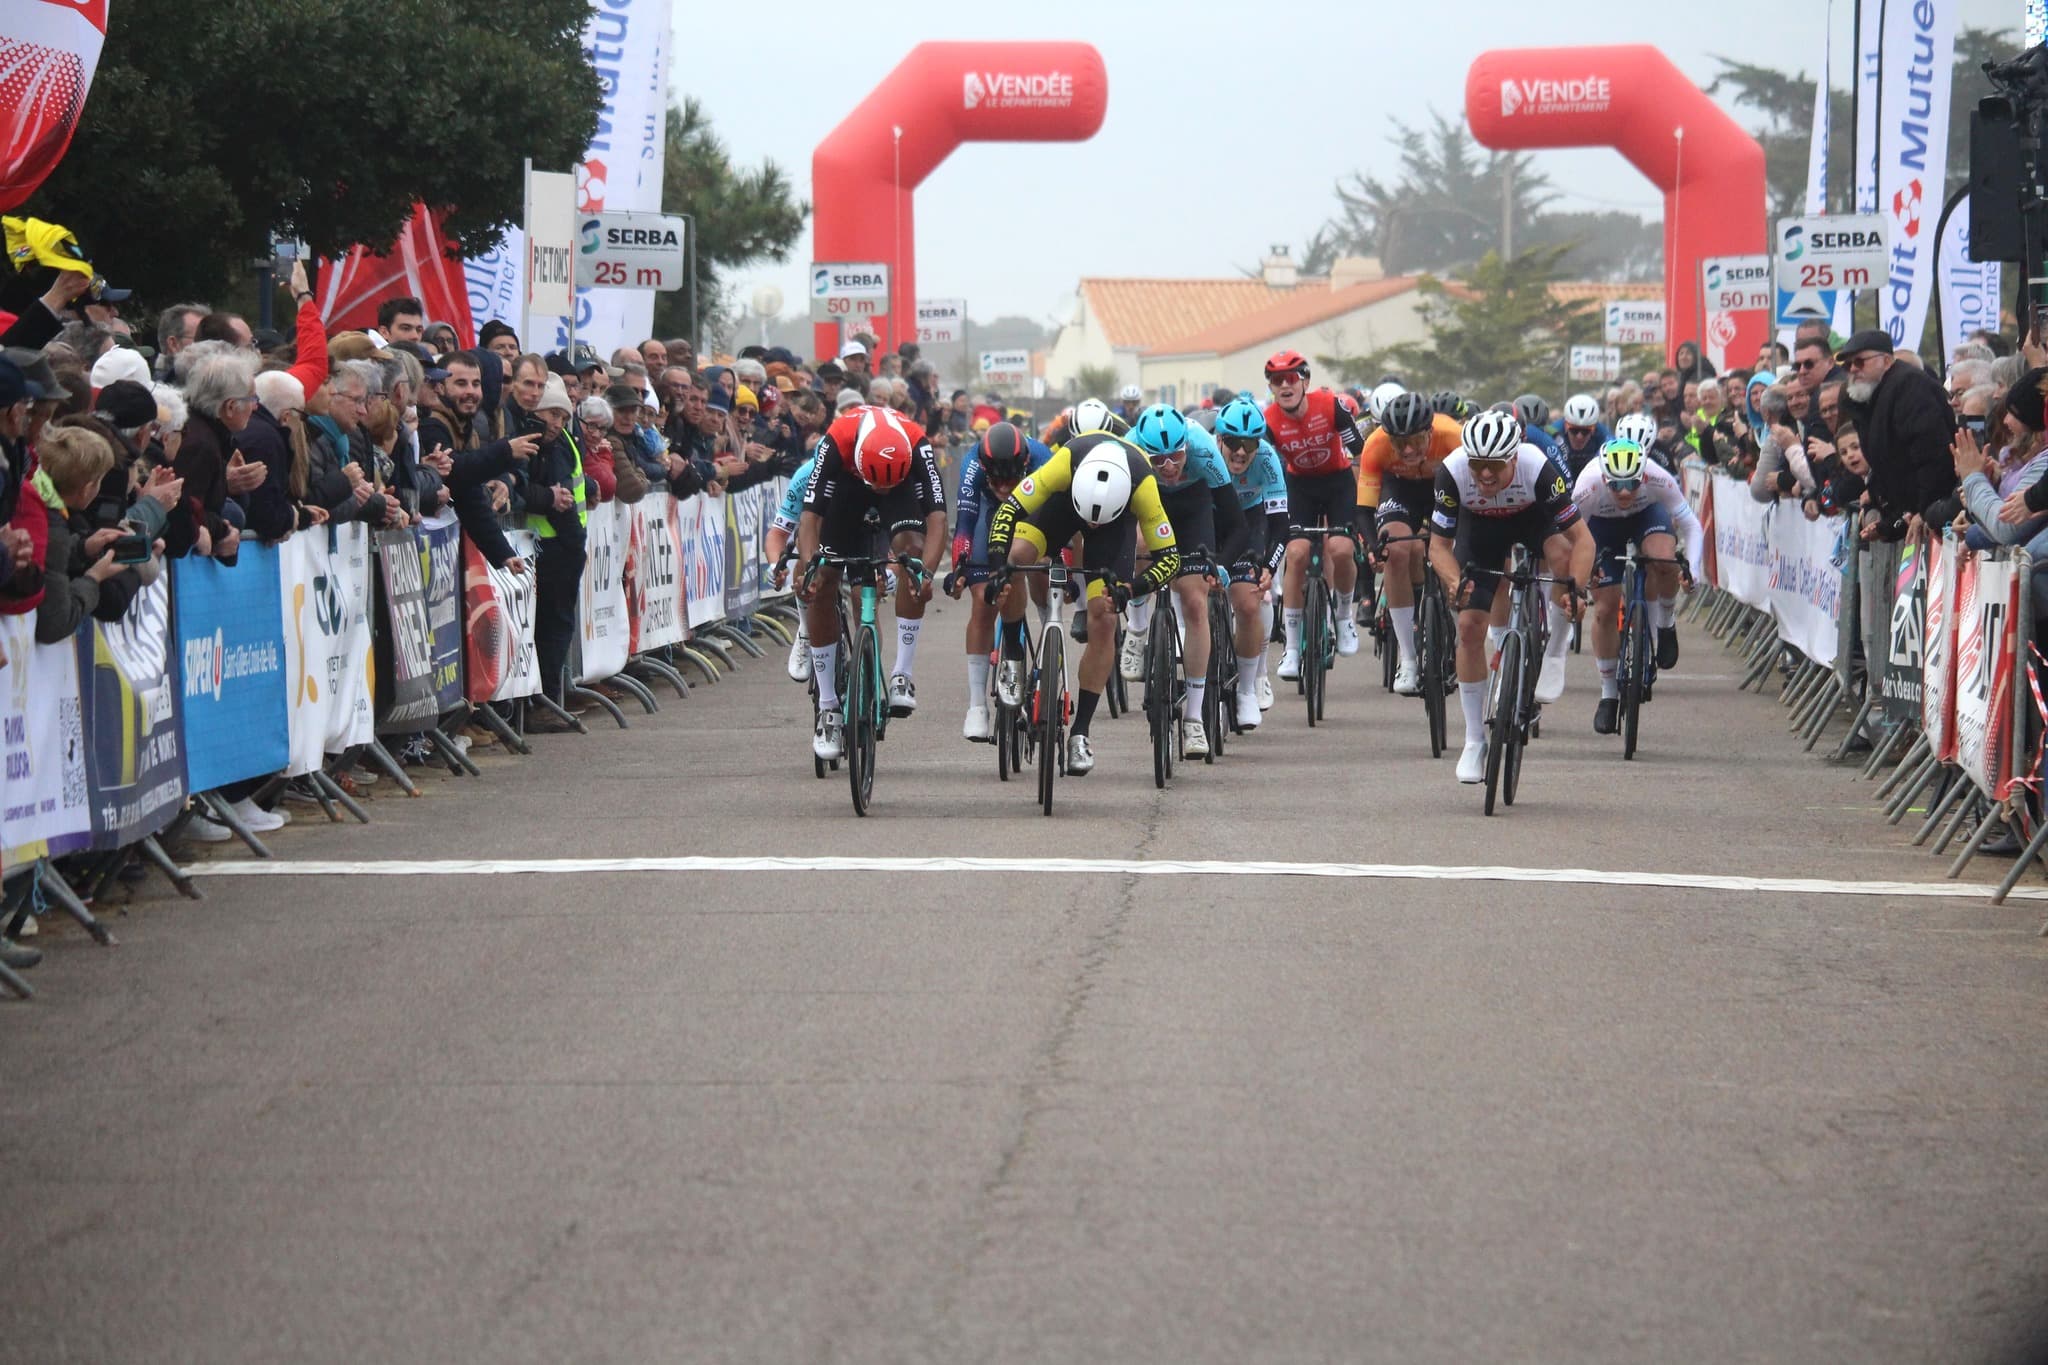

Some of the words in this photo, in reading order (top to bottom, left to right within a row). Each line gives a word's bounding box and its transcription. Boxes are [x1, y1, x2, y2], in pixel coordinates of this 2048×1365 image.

[985, 72, 1073, 97] VENDÉE
[1522, 76, 1610, 103] VENDÉE
[606, 229, 679, 246] SERBA
[1810, 231, 1883, 247] SERBA
[533, 246, 570, 284] PIETONS
[594, 262, 628, 286] 25
[637, 266, 663, 286] m
[833, 274, 884, 287] SERBA
[1800, 264, 1834, 288] 25
[1843, 267, 1869, 285] m
[828, 298, 851, 314] 50
[857, 301, 875, 314] m
[1720, 291, 1746, 308] 50
[1750, 294, 1769, 307] m
[919, 308, 958, 319] SERBA
[1623, 311, 1662, 322] SERBA
[936, 330, 951, 341] m
[1618, 328, 1636, 342] 75
[1640, 330, 1656, 342] m
[986, 372, 1006, 383] 100
[1011, 374, 1023, 383] m
[808, 442, 830, 489] LEGENDRE
[964, 459, 980, 486] PARIS
[926, 457, 944, 504] LEGENDRE
[1159, 526, 1169, 536] U
[185, 636, 213, 697] SUPER
